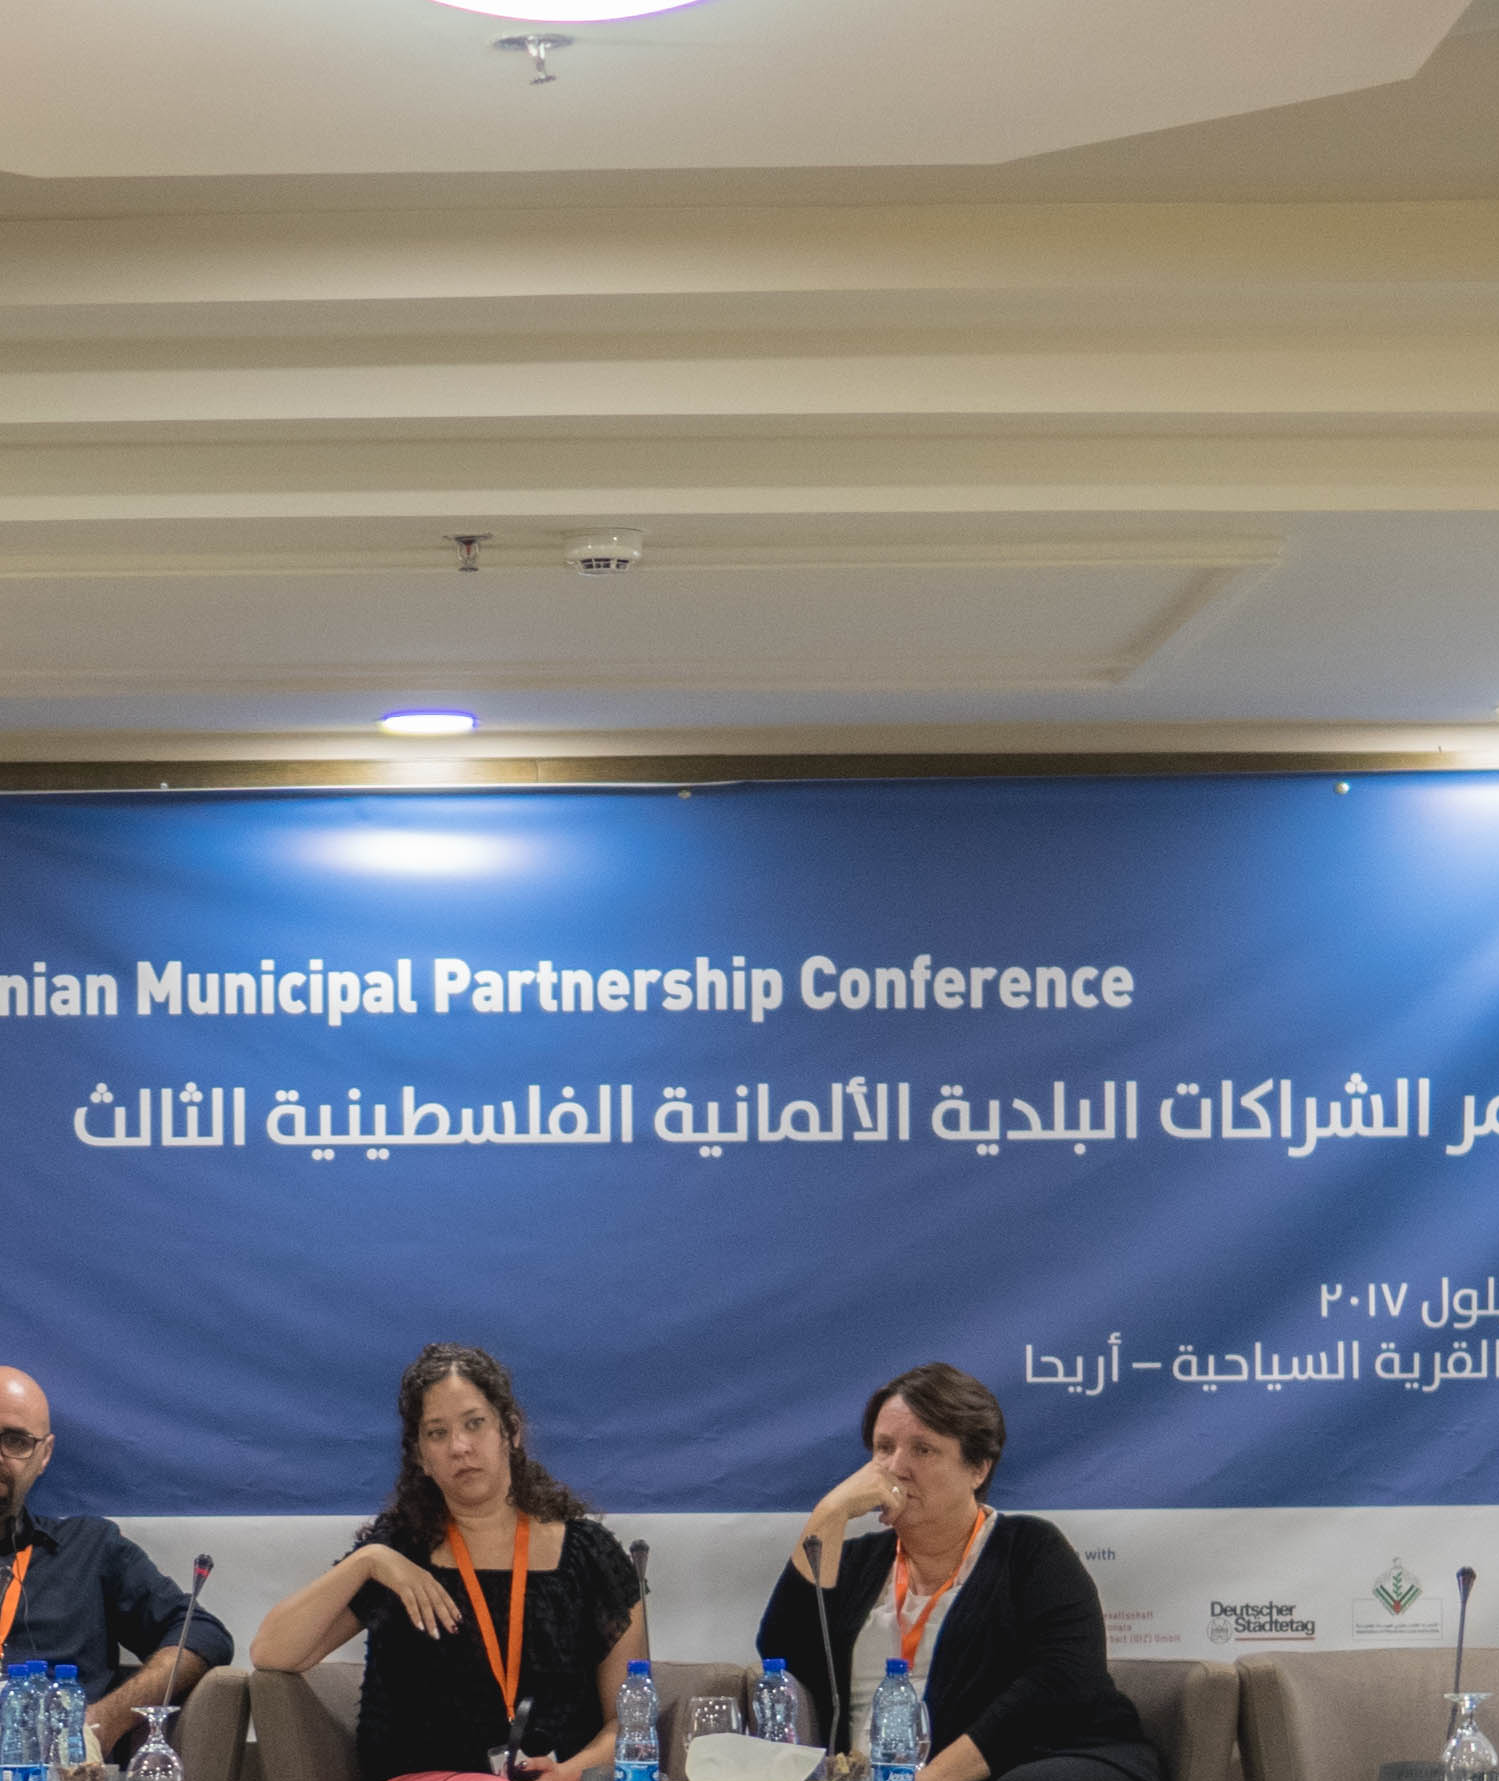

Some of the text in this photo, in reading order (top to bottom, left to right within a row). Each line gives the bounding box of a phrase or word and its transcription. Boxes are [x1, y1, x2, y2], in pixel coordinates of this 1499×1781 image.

[137, 958, 418, 1027] Municipal
[433, 956, 783, 1023] Partnership
[801, 954, 1134, 1010] Conference
[73, 1081, 246, 1147] الثالث
[266, 1084, 633, 1161] الفلسطينية
[653, 1076, 910, 1158] الألمانية
[931, 1081, 1137, 1156] البلدية
[1160, 1072, 1430, 1158] الشراكات
[1320, 1282, 1409, 1318] ٢٠١٧
[1025, 1332, 1122, 1396] أريحا
[1172, 1340, 1360, 1392] السياحية
[1085, 1548, 1116, 1561] with
[1210, 1601, 1296, 1618] Deutscher
